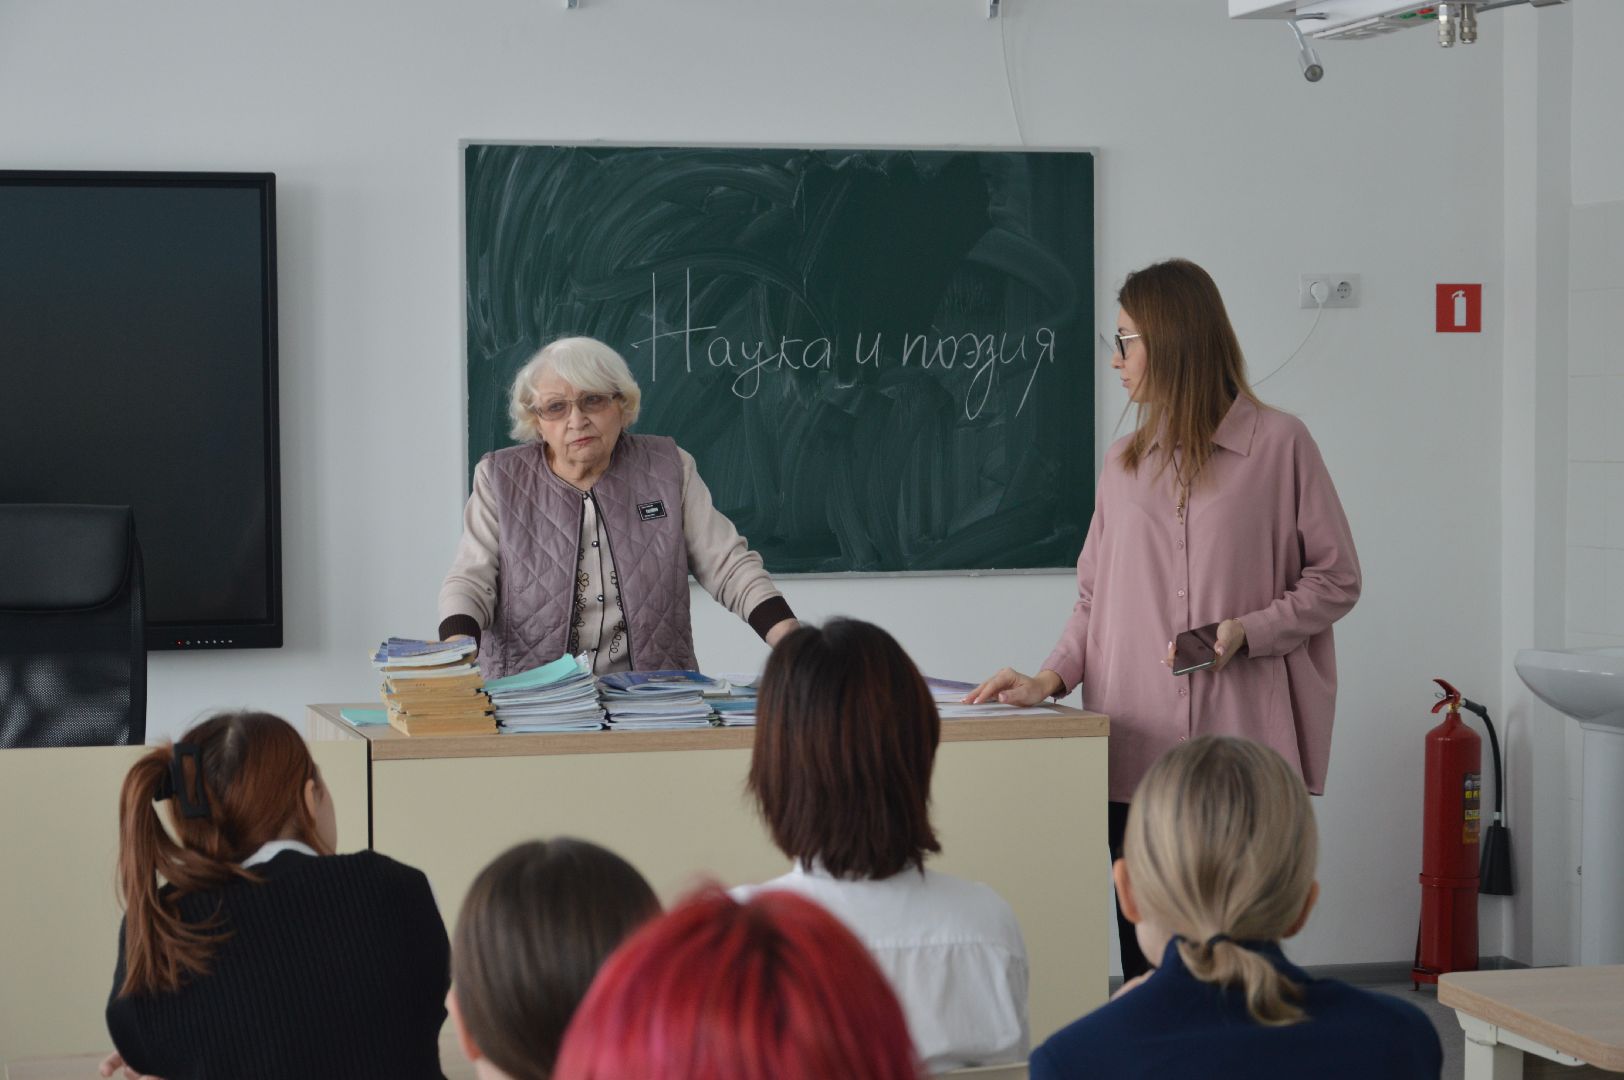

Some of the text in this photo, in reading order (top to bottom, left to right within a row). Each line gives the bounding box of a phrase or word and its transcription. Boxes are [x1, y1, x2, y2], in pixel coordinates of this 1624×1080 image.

[631, 267, 1056, 421] Наука и поэзия
